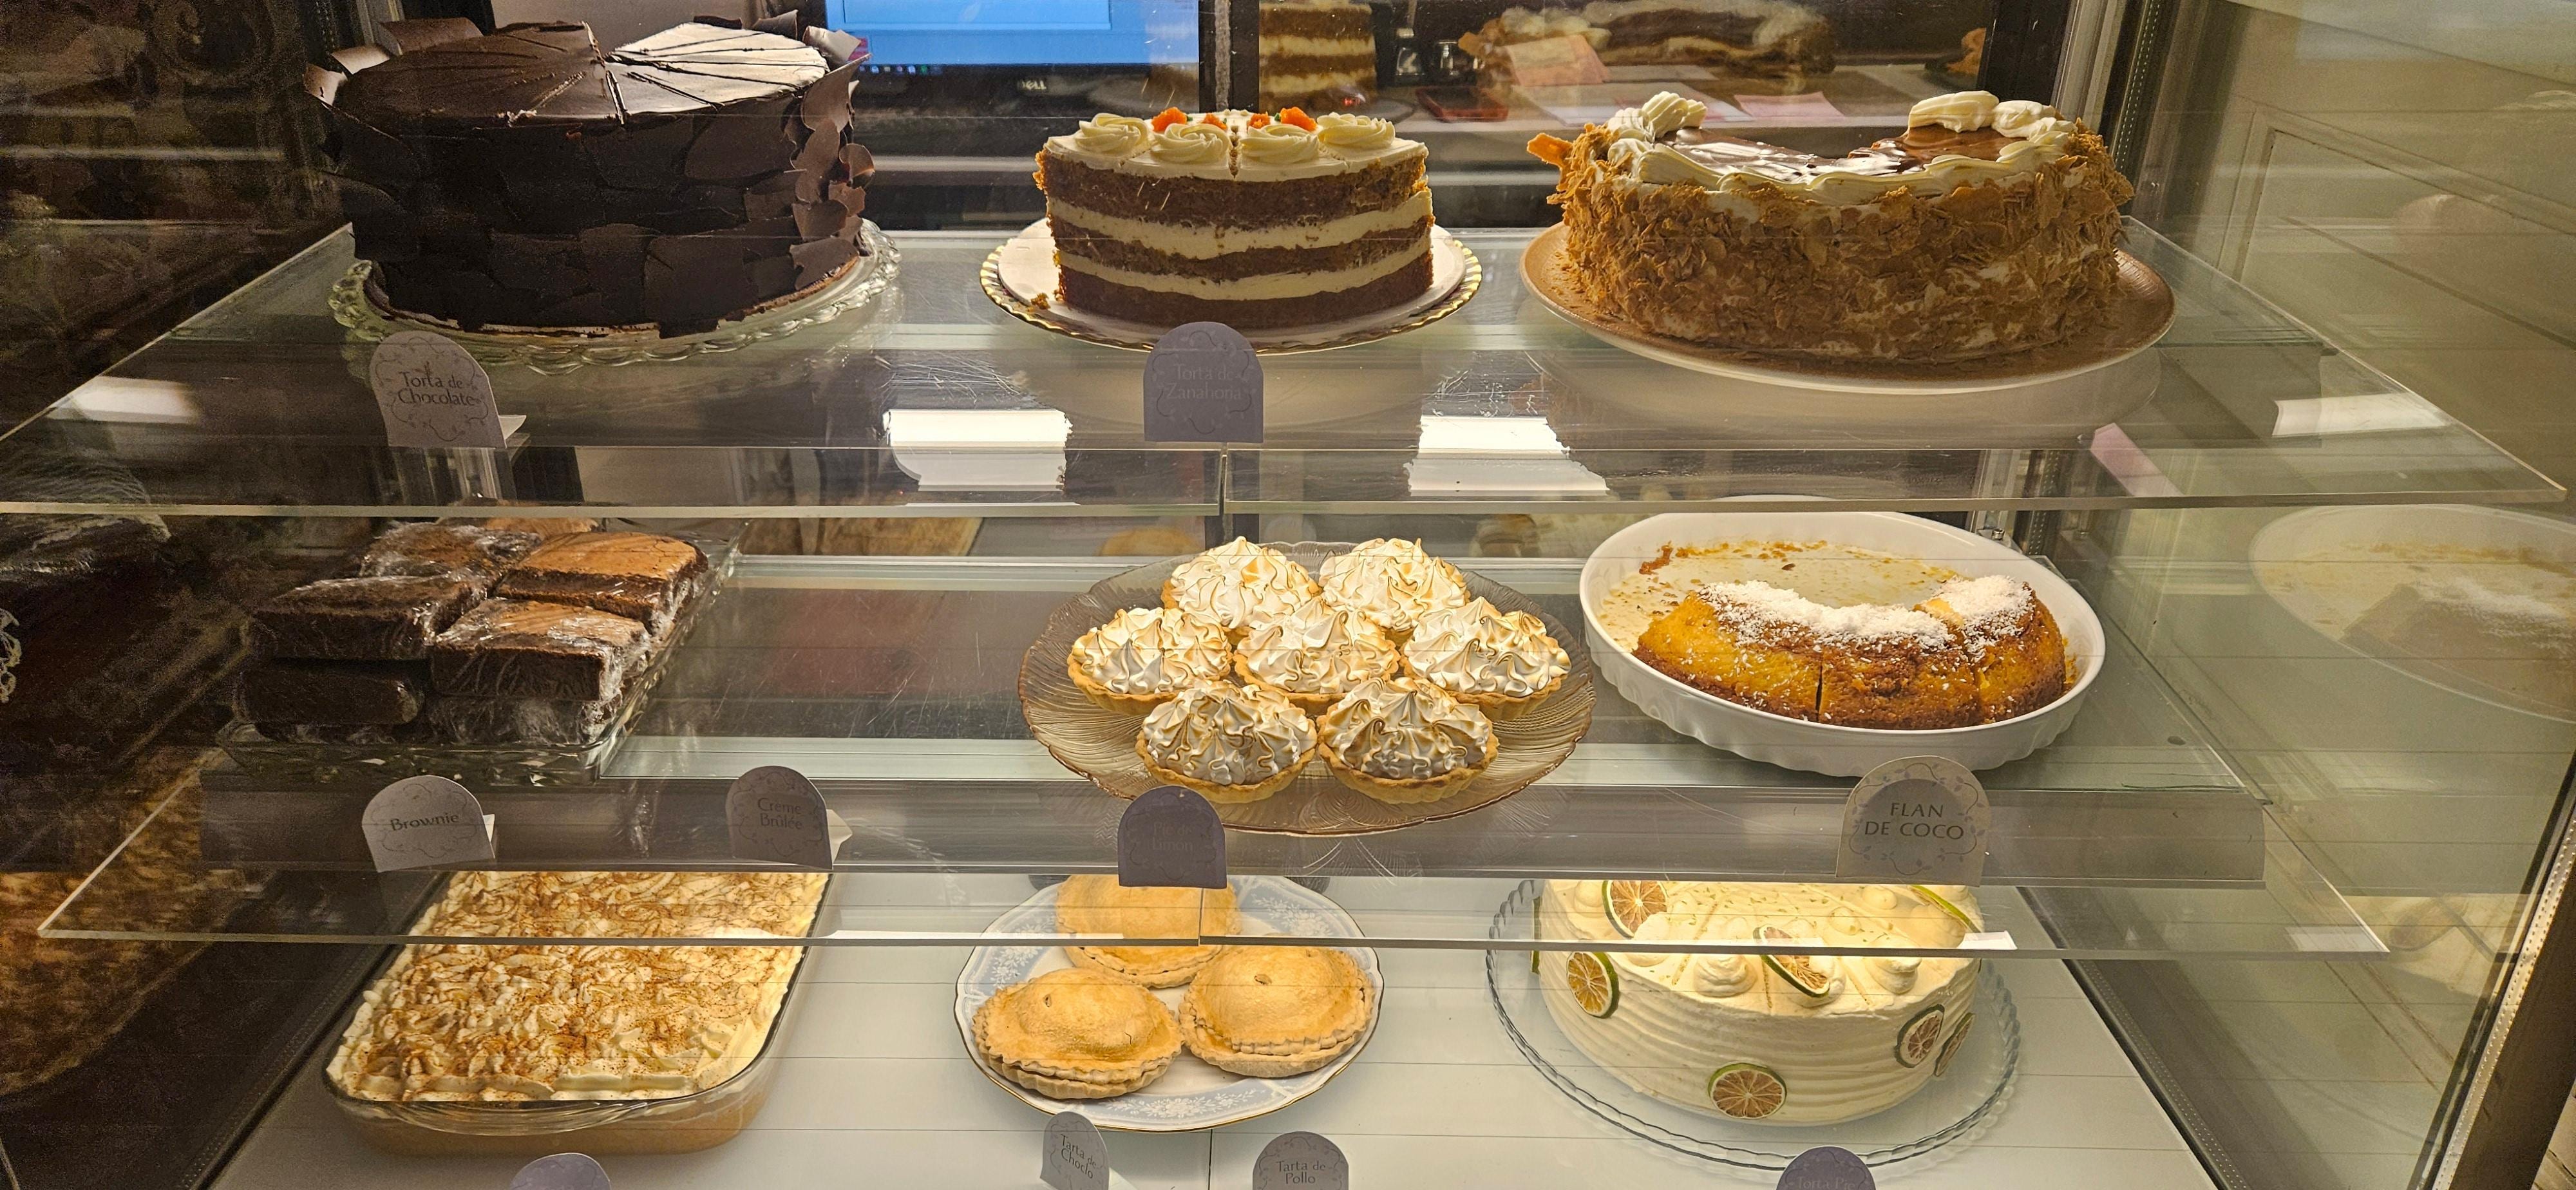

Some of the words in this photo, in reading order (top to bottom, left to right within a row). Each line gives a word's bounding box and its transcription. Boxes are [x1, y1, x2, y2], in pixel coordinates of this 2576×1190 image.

[399, 370, 442, 387] Torta
[448, 375, 462, 389] de
[1173, 363, 1213, 381] Torta
[397, 388, 477, 406] Chocolate
[1890, 802, 1944, 818] FLAN
[390, 812, 460, 831] Brownie
[759, 813, 803, 831] Brûlée
[1864, 821, 1891, 836] DE
[1900, 822, 1964, 840] COCO
[1061, 1133, 1085, 1160] Tarta
[1087, 1155, 1097, 1167] de
[1061, 1148, 1094, 1179] Choclo
[1276, 1160, 1308, 1172] Tarta
[1312, 1160, 1326, 1171] de
[1285, 1172, 1316, 1184] Pollo
